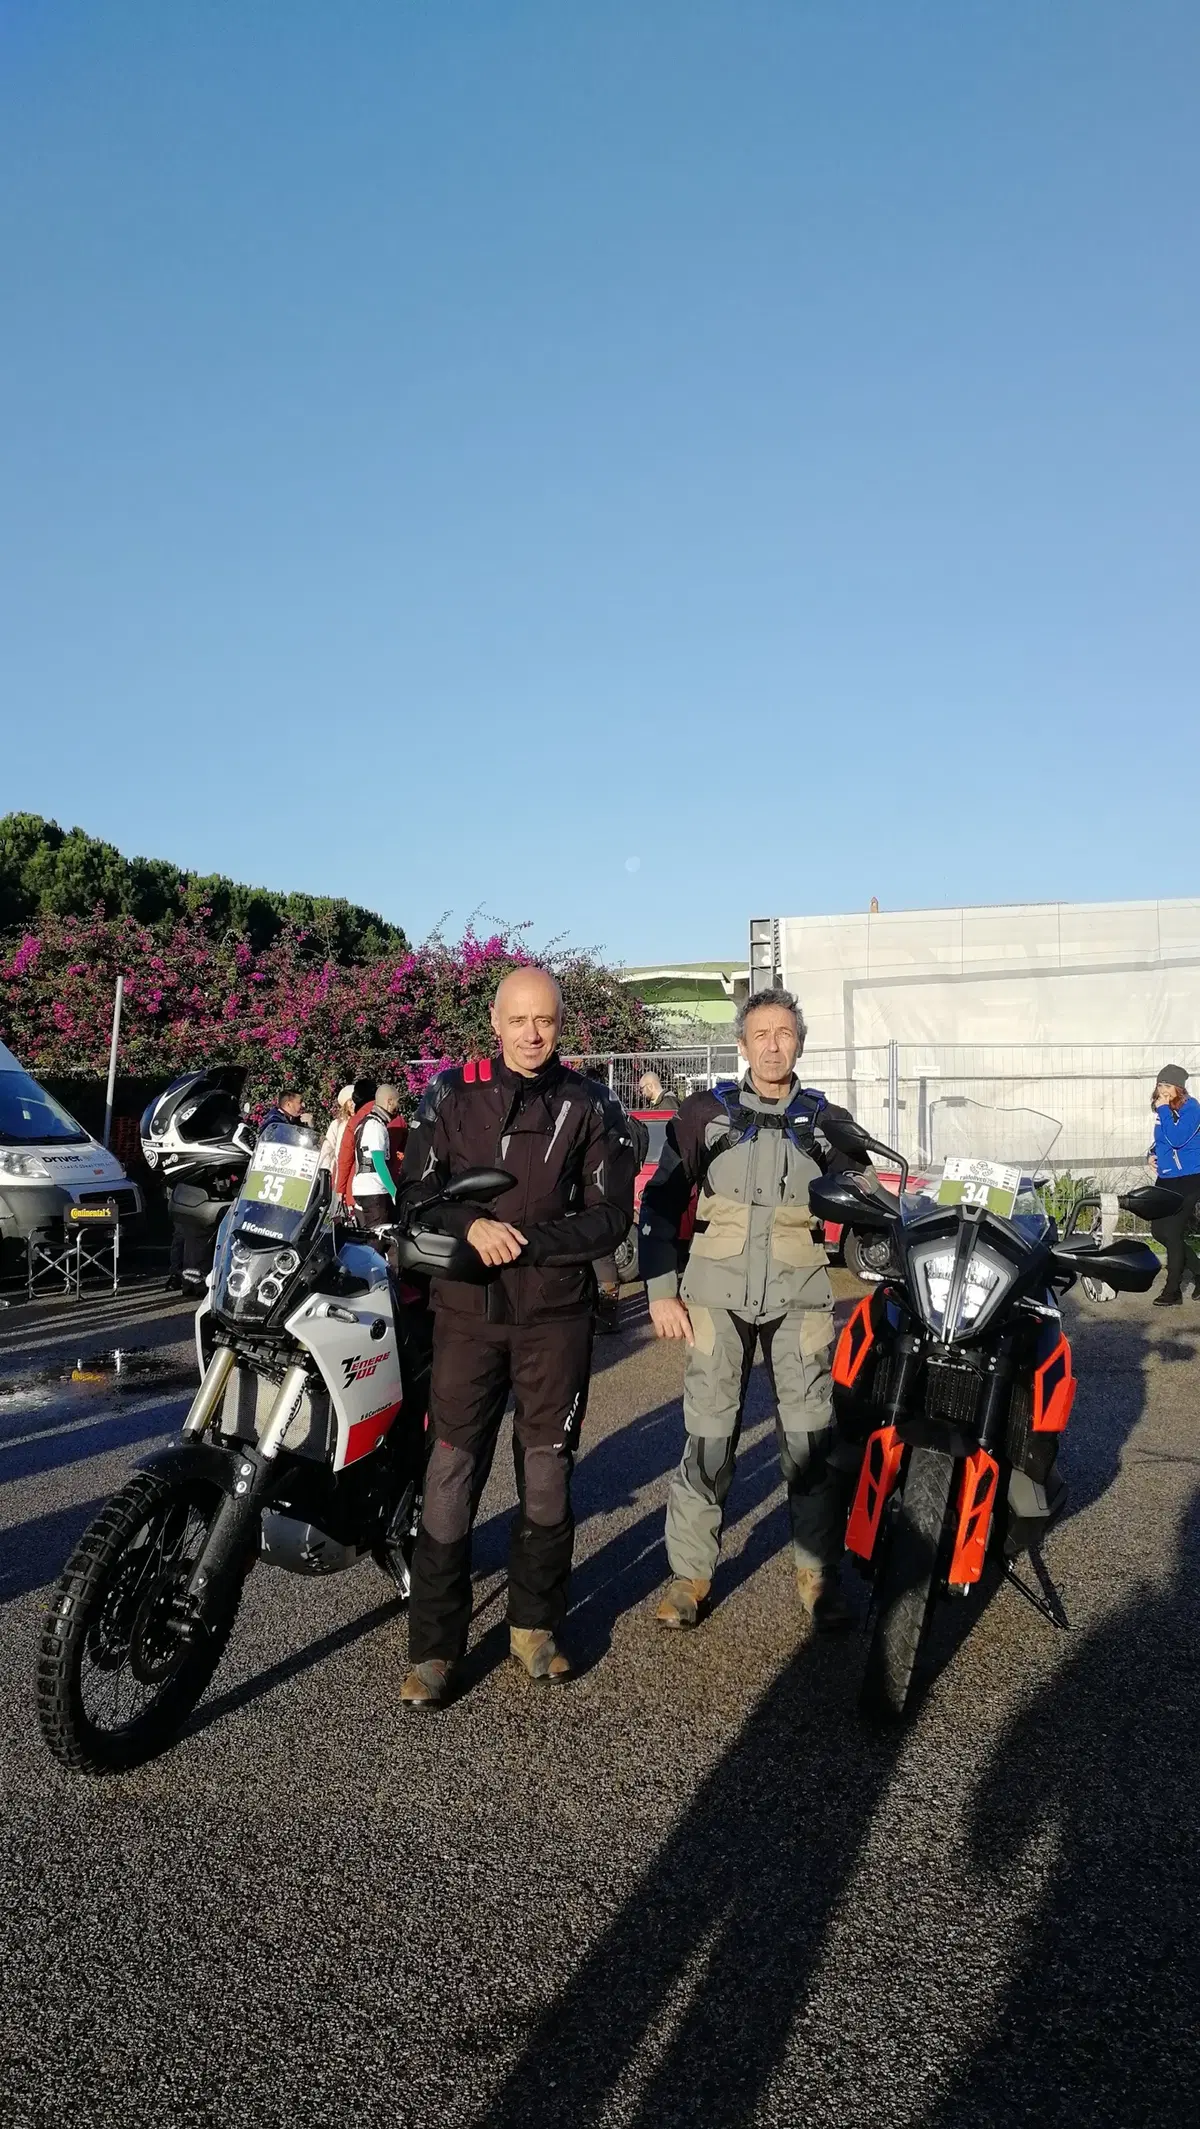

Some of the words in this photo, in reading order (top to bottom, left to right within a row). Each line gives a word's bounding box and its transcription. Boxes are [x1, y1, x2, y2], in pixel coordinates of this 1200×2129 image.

[258, 1174, 286, 1202] 35
[960, 1181, 990, 1206] 34
[70, 1207, 105, 1219] Continental
[342, 1365, 377, 1389] 700
